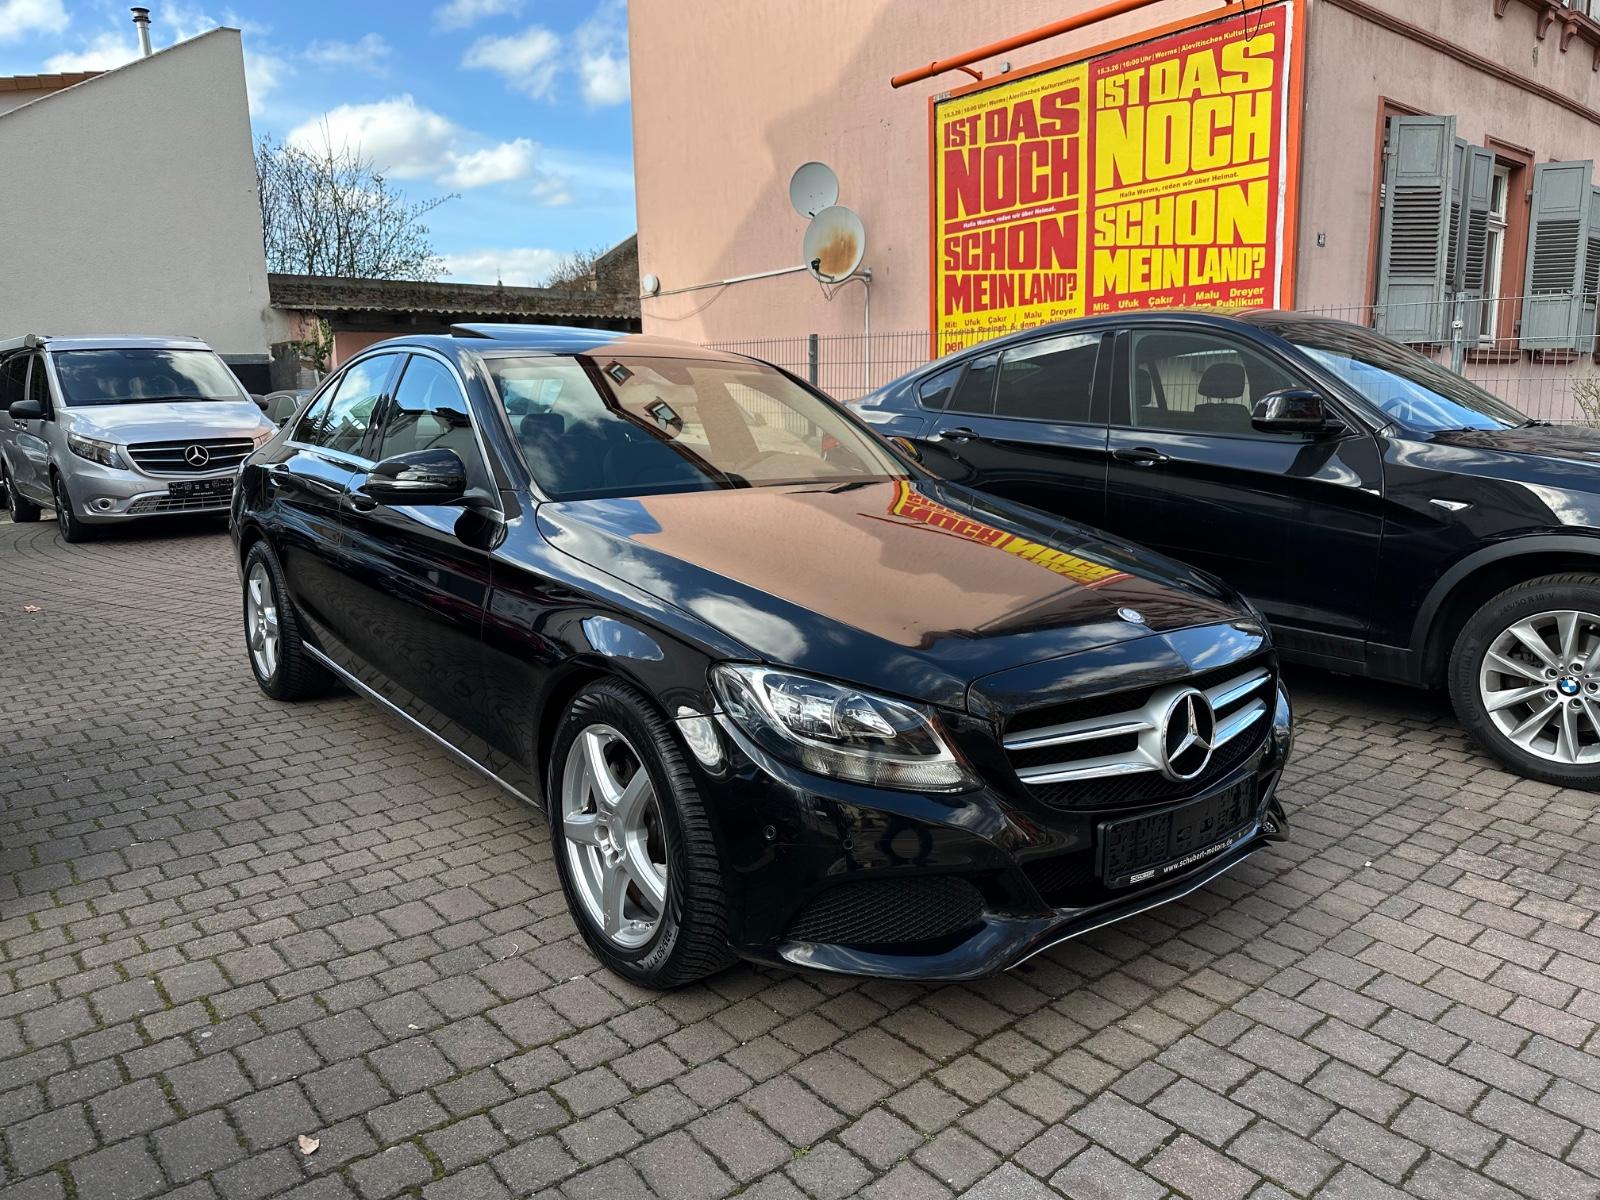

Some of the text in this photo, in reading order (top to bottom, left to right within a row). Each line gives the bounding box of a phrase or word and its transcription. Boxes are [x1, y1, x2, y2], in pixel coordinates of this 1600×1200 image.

[1096, 33, 1275, 109] IST DAS
[1122, 57, 1139, 68] 16:00
[1140, 55, 1152, 63] Uhr
[1155, 49, 1177, 59] Worms
[1181, 36, 1222, 52] Alevitisches
[964, 104, 977, 114] 16:00
[977, 102, 987, 110] Uhr
[989, 98, 1005, 107] Worms
[1009, 87, 1040, 100] Alevitisches
[1040, 76, 1080, 91] Kulturzentrum
[944, 87, 1080, 148] IST DAS
[1095, 91, 1272, 191] NOCH
[944, 136, 1079, 220] NOCH
[1120, 171, 1238, 198] Hallo Worms, reden wir über Heimat.
[963, 221, 976, 229] Hallo
[996, 214, 1011, 222] reden
[1021, 209, 1034, 217] über
[1034, 205, 1056, 214] Heimat.
[1094, 179, 1269, 246] SCHON
[944, 214, 1078, 271] SCHON
[1093, 247, 1266, 297] MEIN LAND?
[944, 273, 1077, 316] MEIN LAND?
[1093, 302, 1109, 312] Mit:
[1118, 299, 1139, 308] Ufuk
[1148, 296, 1174, 307] Çakır
[1195, 290, 1219, 300] Malu
[1229, 287, 1264, 297] Dreyer
[1216, 298, 1264, 308] Publikum
[945, 321, 957, 330] Mit:
[964, 318, 980, 326] Ufuk
[987, 315, 1007, 325] Çakır
[1023, 311, 1042, 319] Malu
[1050, 307, 1077, 316] Dreyer
[1020, 321, 1036, 329] dem
[1163, 838, 1233, 873] www.schubert-motors.de
